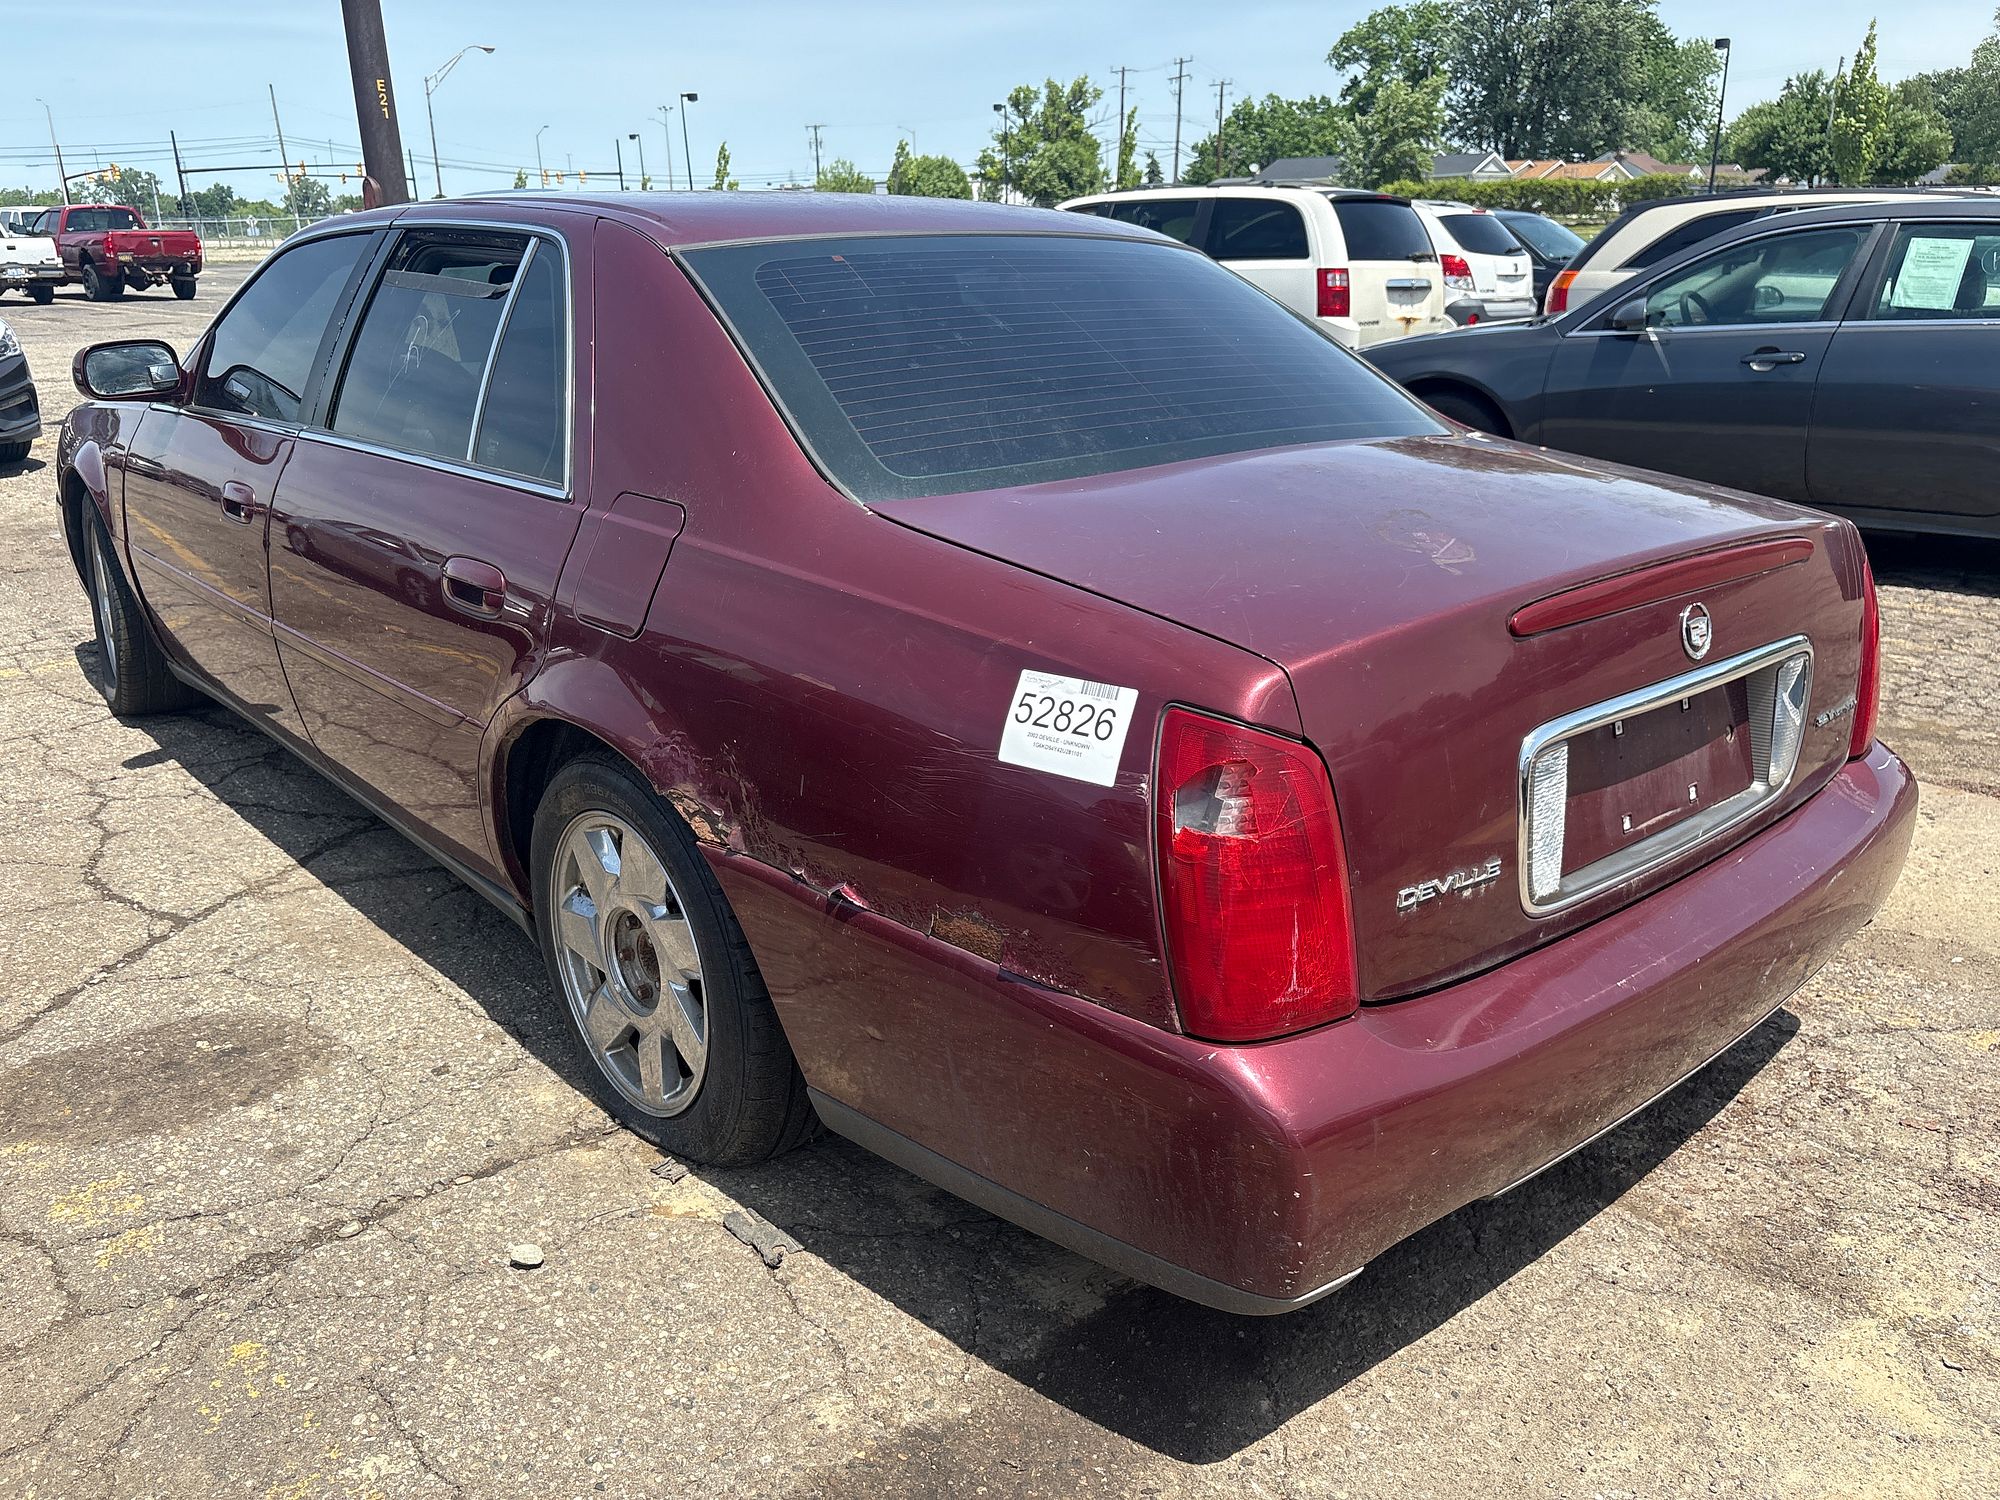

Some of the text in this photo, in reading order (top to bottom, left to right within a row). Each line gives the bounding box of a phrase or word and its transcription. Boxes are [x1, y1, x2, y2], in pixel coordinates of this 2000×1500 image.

[1015, 692, 1116, 741] 52826
[1039, 733, 1060, 744] DEVILLE
[1063, 739, 1091, 750] UNKNOWN
[1397, 859, 1502, 909] DEVILLE
